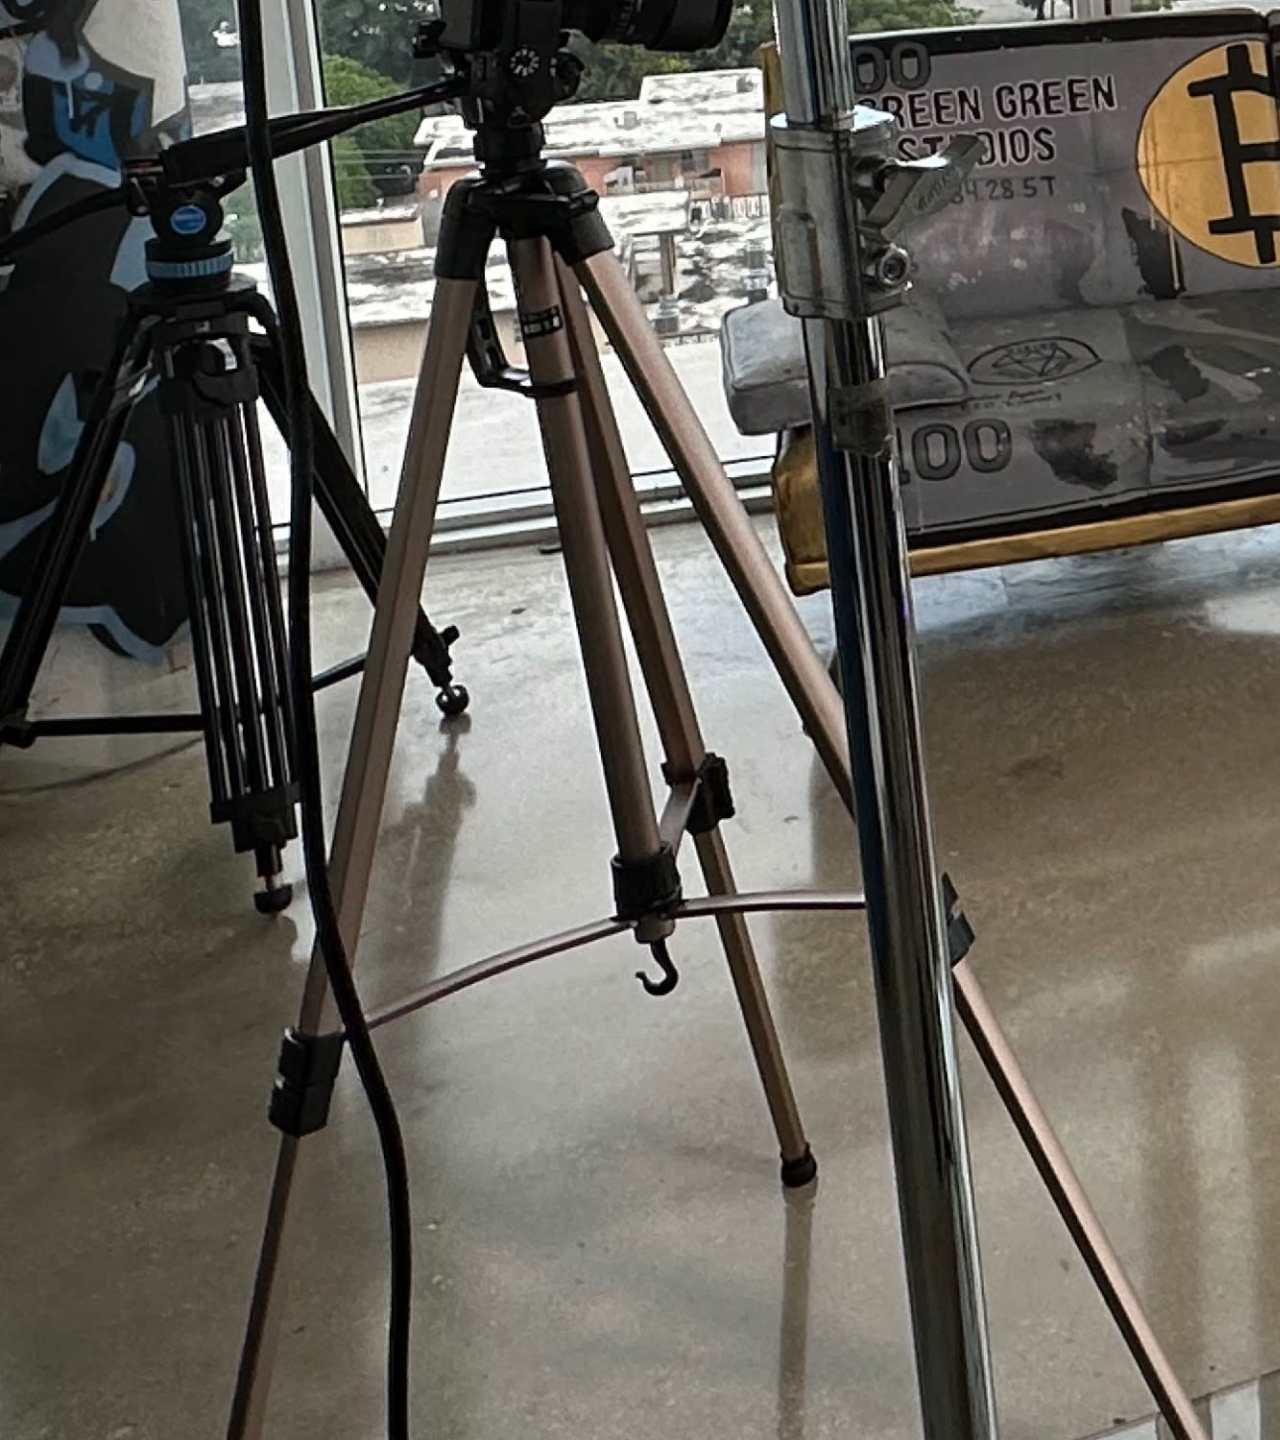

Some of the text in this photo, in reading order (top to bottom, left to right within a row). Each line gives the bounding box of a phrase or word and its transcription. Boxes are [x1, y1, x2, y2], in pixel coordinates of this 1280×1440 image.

[994, 75, 1117, 121] GREEN
[898, 126, 1057, 167] STDIOS
[985, 177, 1015, 201] 28
